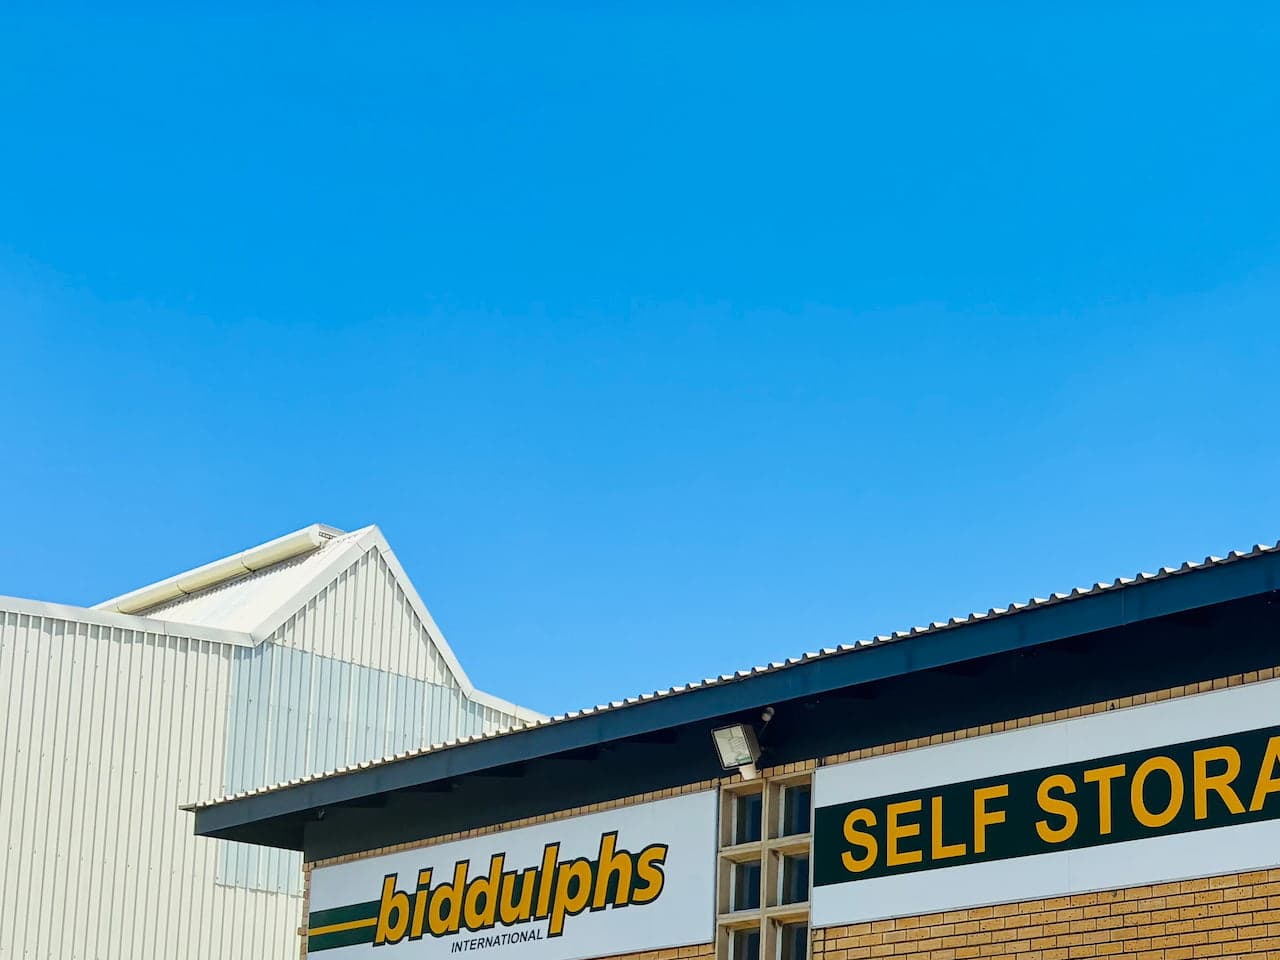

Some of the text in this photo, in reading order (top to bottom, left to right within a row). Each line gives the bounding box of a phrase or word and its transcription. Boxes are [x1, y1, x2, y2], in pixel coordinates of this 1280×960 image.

[841, 783, 1009, 873] SELF
[373, 830, 668, 945] biddulphs
[451, 929, 543, 953] INTERNATIONAL
